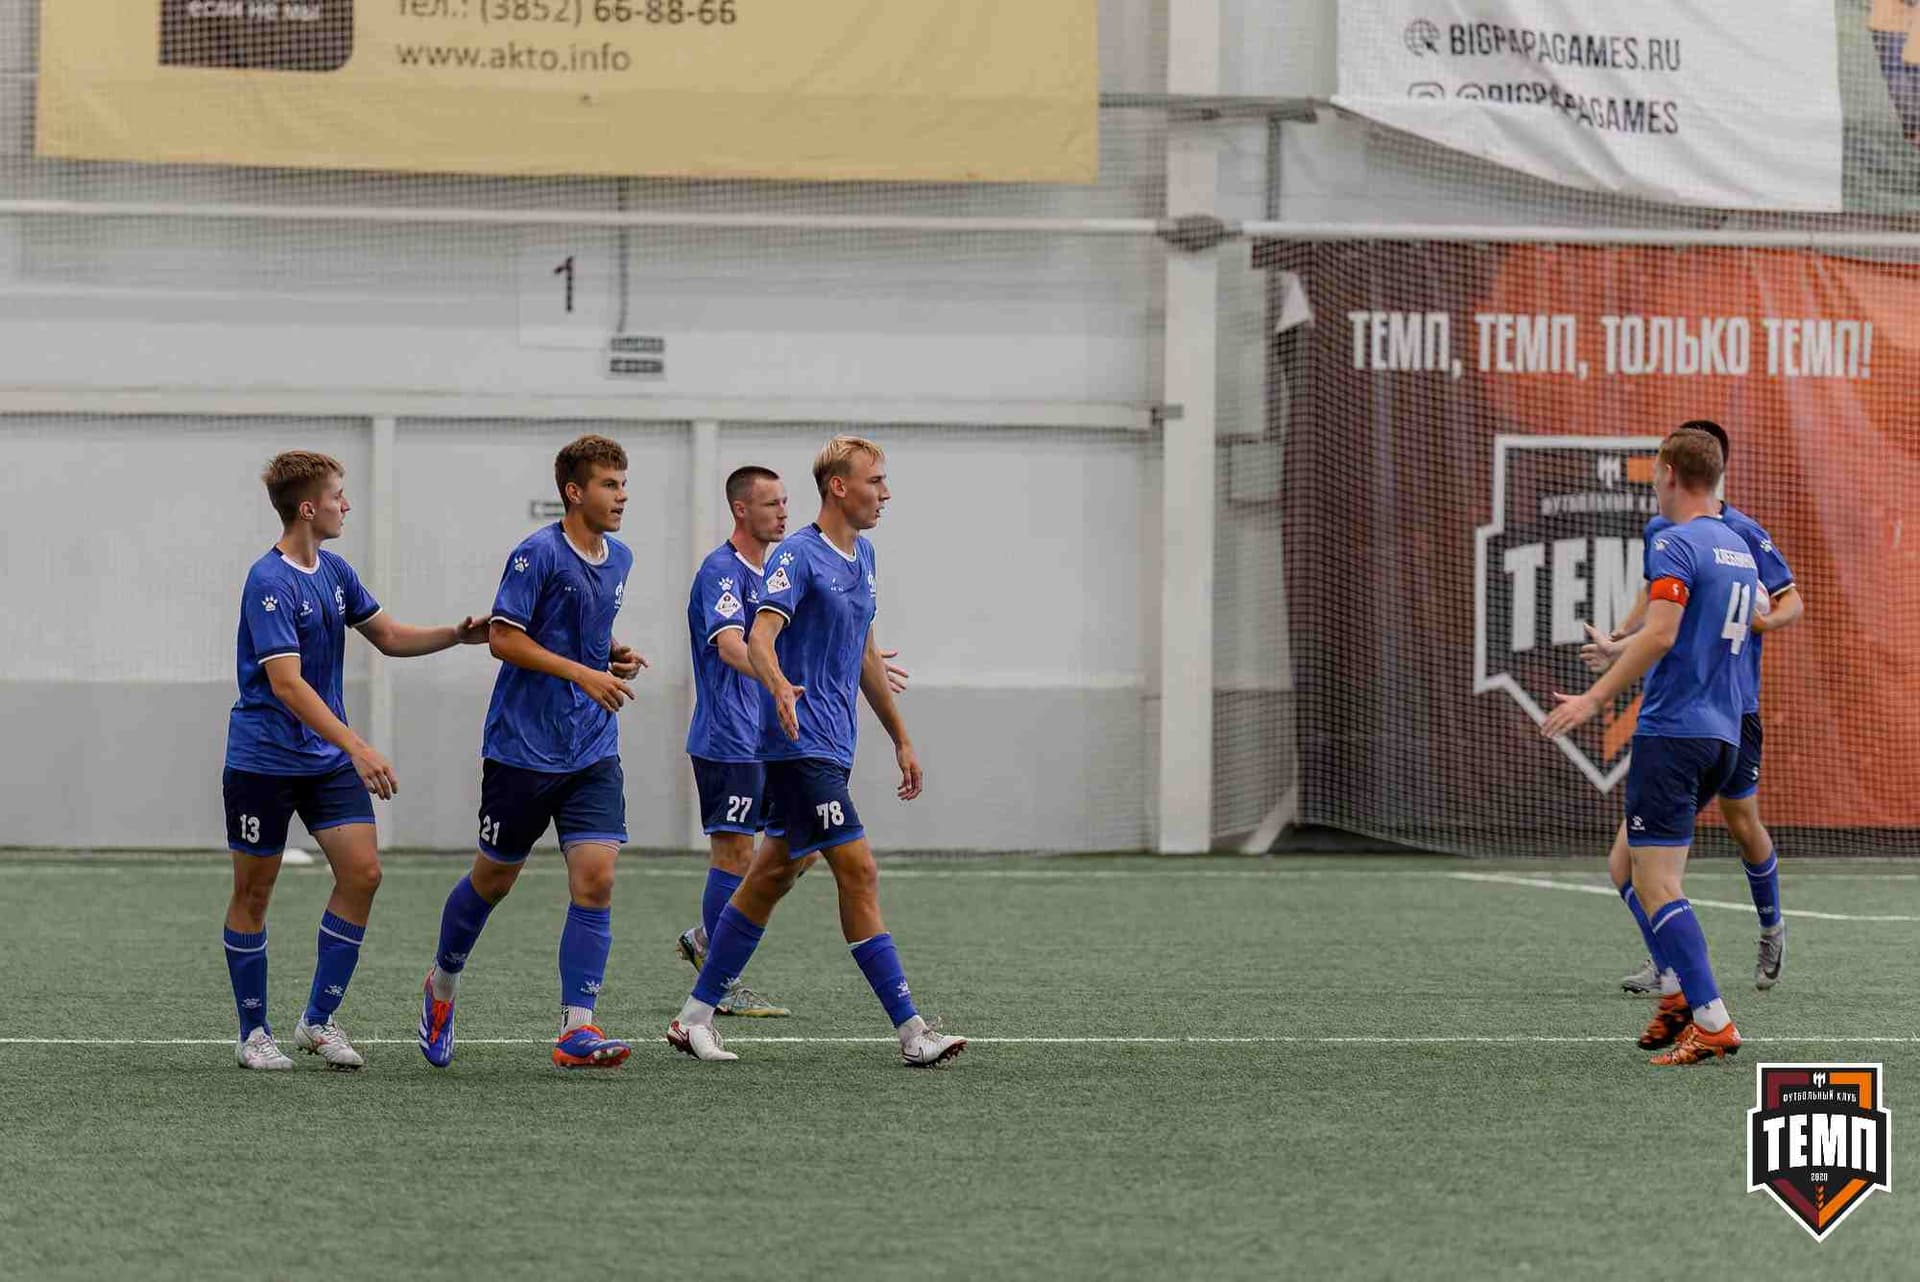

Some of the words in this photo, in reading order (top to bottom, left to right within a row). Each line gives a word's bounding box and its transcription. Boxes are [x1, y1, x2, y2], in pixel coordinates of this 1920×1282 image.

[480, 0, 583, 27] (3852)
[593, 0, 738, 25] 66-88-66
[395, 42, 632, 72] www.akto.info
[1450, 22, 1681, 71] BIGPAPAGAMES.RU
[553, 255, 574, 313] 1
[1348, 311, 1462, 378] ТЕМП,
[1474, 312, 1588, 380] ТЕМП,
[1602, 314, 1750, 377] ТОЛЬКО
[1763, 317, 1874, 378] ТЕМП!
[1721, 582, 1750, 655] 4
[726, 795, 753, 823] 27
[816, 800, 845, 830] 78
[240, 814, 260, 843] 13
[481, 815, 500, 846] 21
